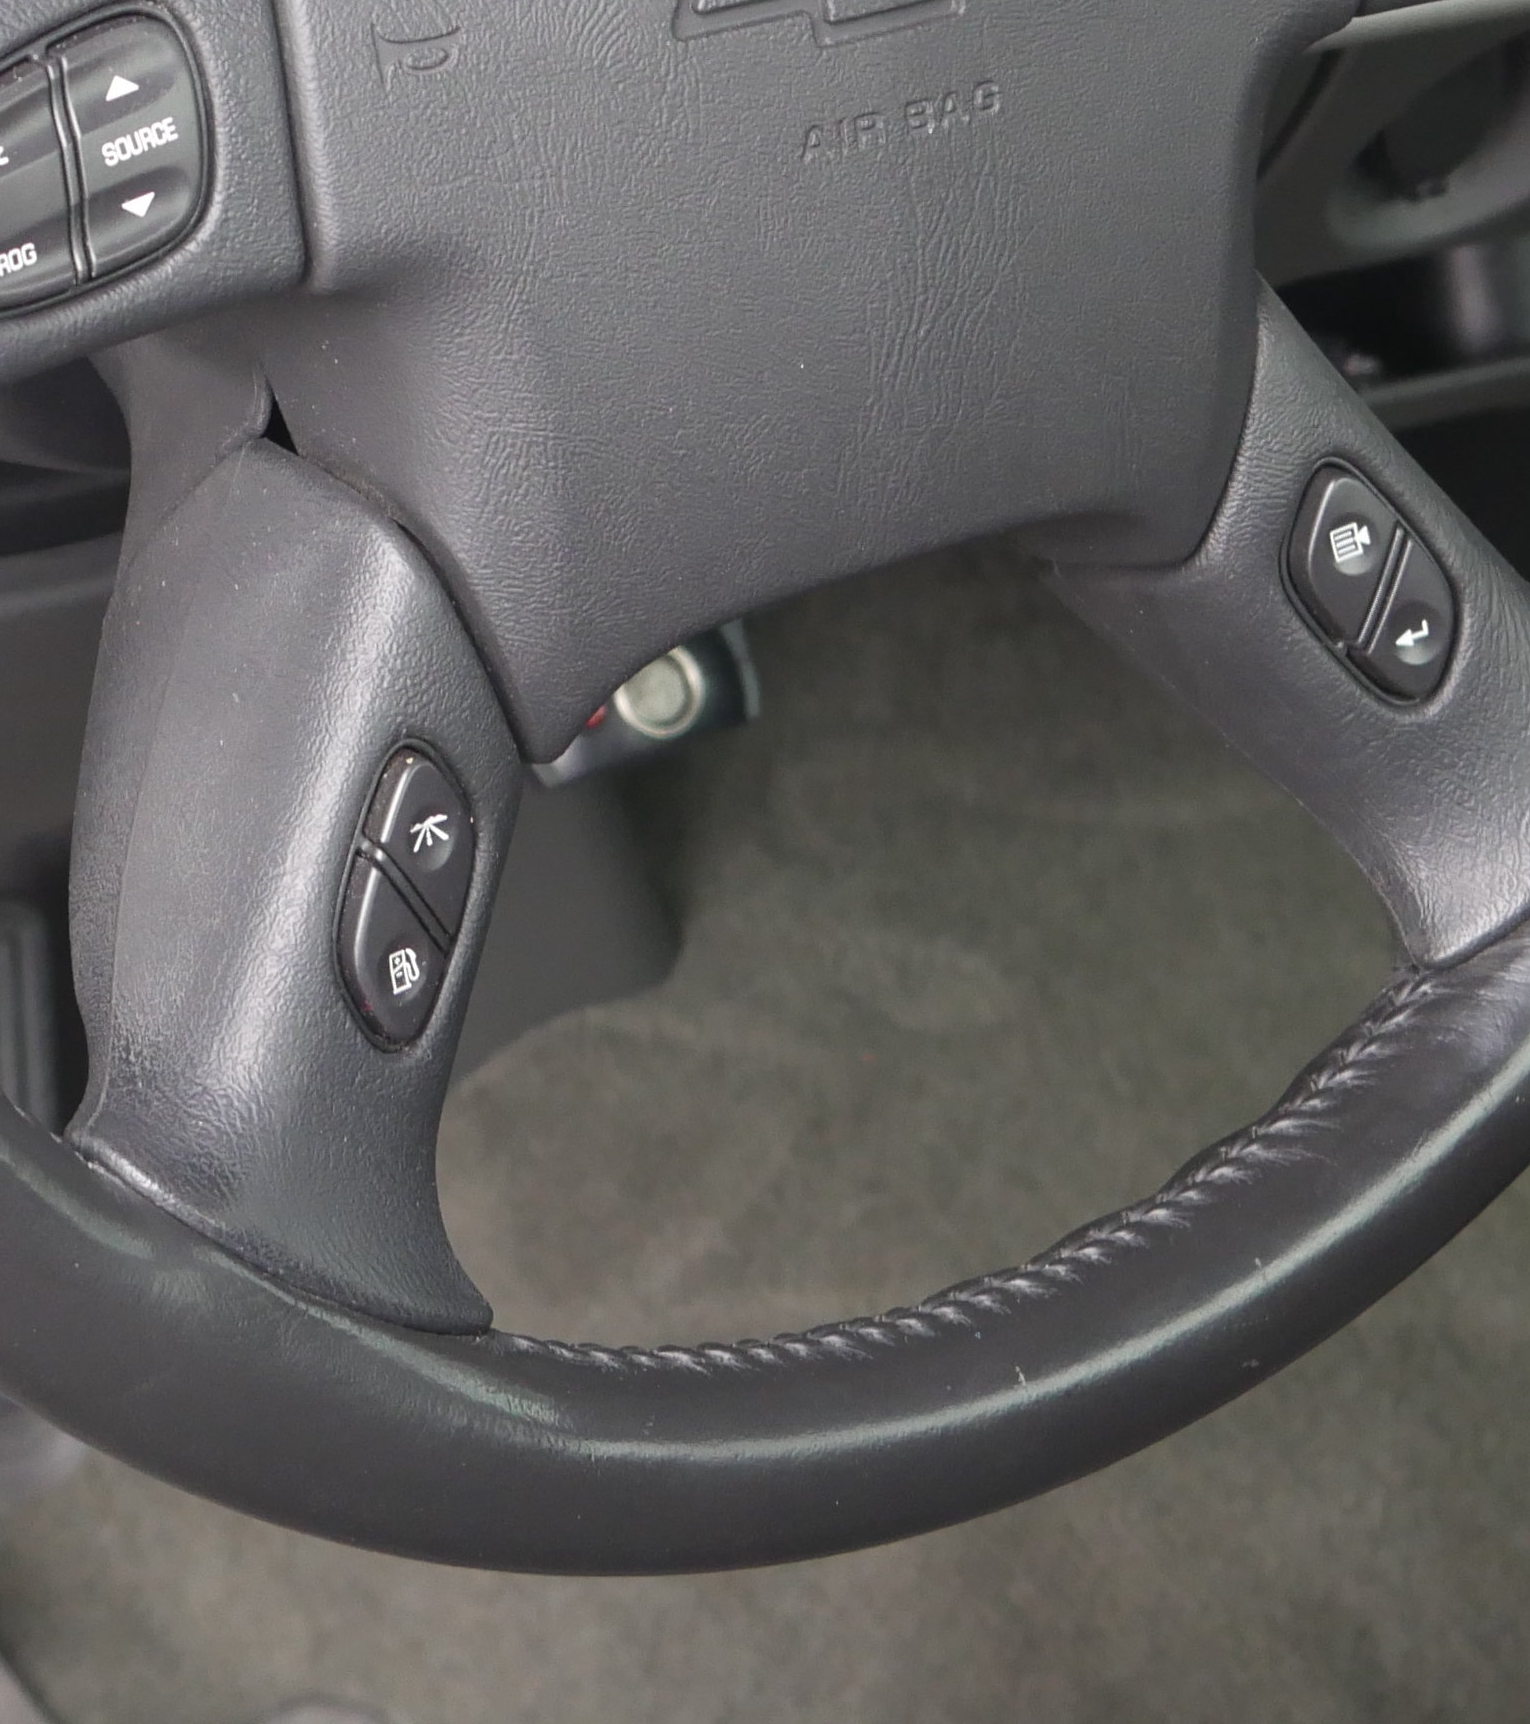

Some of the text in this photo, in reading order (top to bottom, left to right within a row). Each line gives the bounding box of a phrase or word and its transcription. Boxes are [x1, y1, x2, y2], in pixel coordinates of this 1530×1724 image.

[101, 116, 179, 167] SOURCE
[800, 80, 1003, 162] AIR BAG
